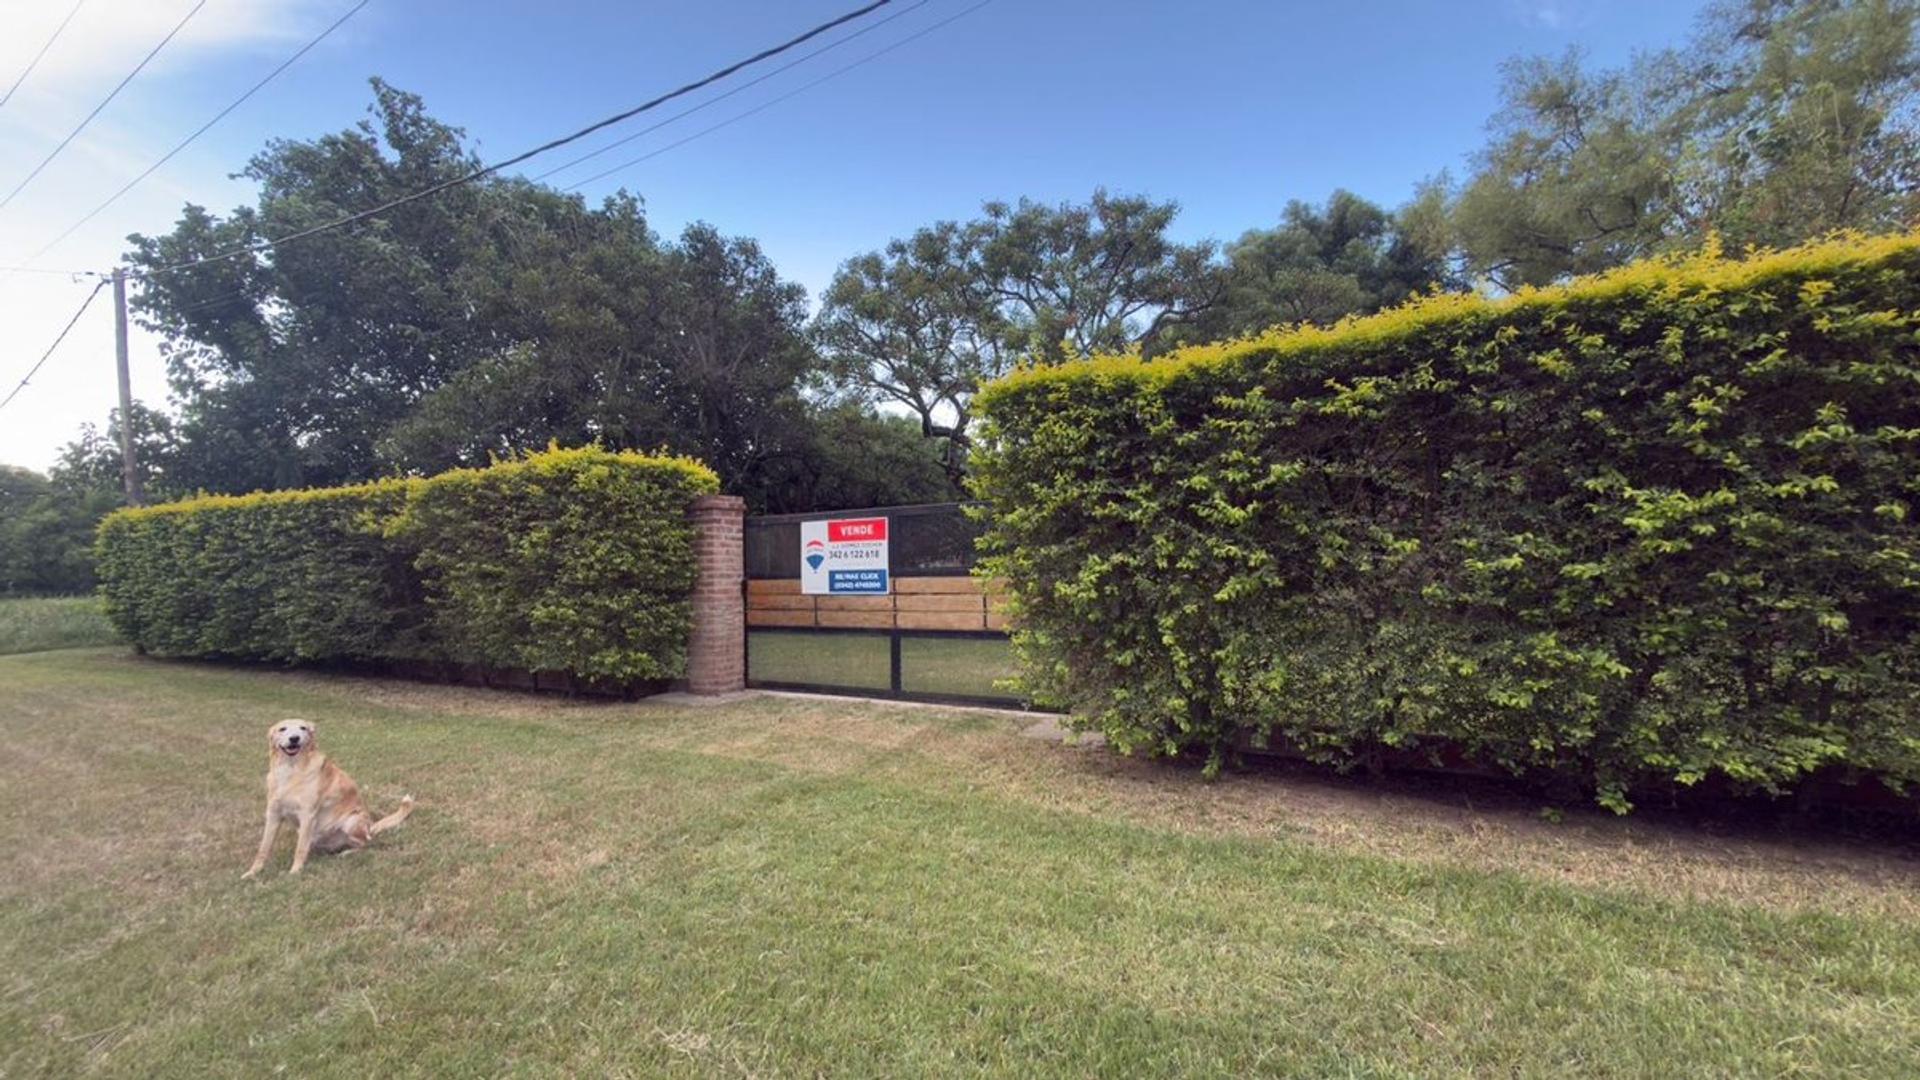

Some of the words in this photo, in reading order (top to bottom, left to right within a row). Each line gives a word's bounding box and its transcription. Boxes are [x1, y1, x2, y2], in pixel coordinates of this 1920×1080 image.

[840, 525, 874, 536] VENDE
[829, 550, 842, 559] 342
[850, 550, 864, 559] 122
[865, 550, 879, 559] 618
